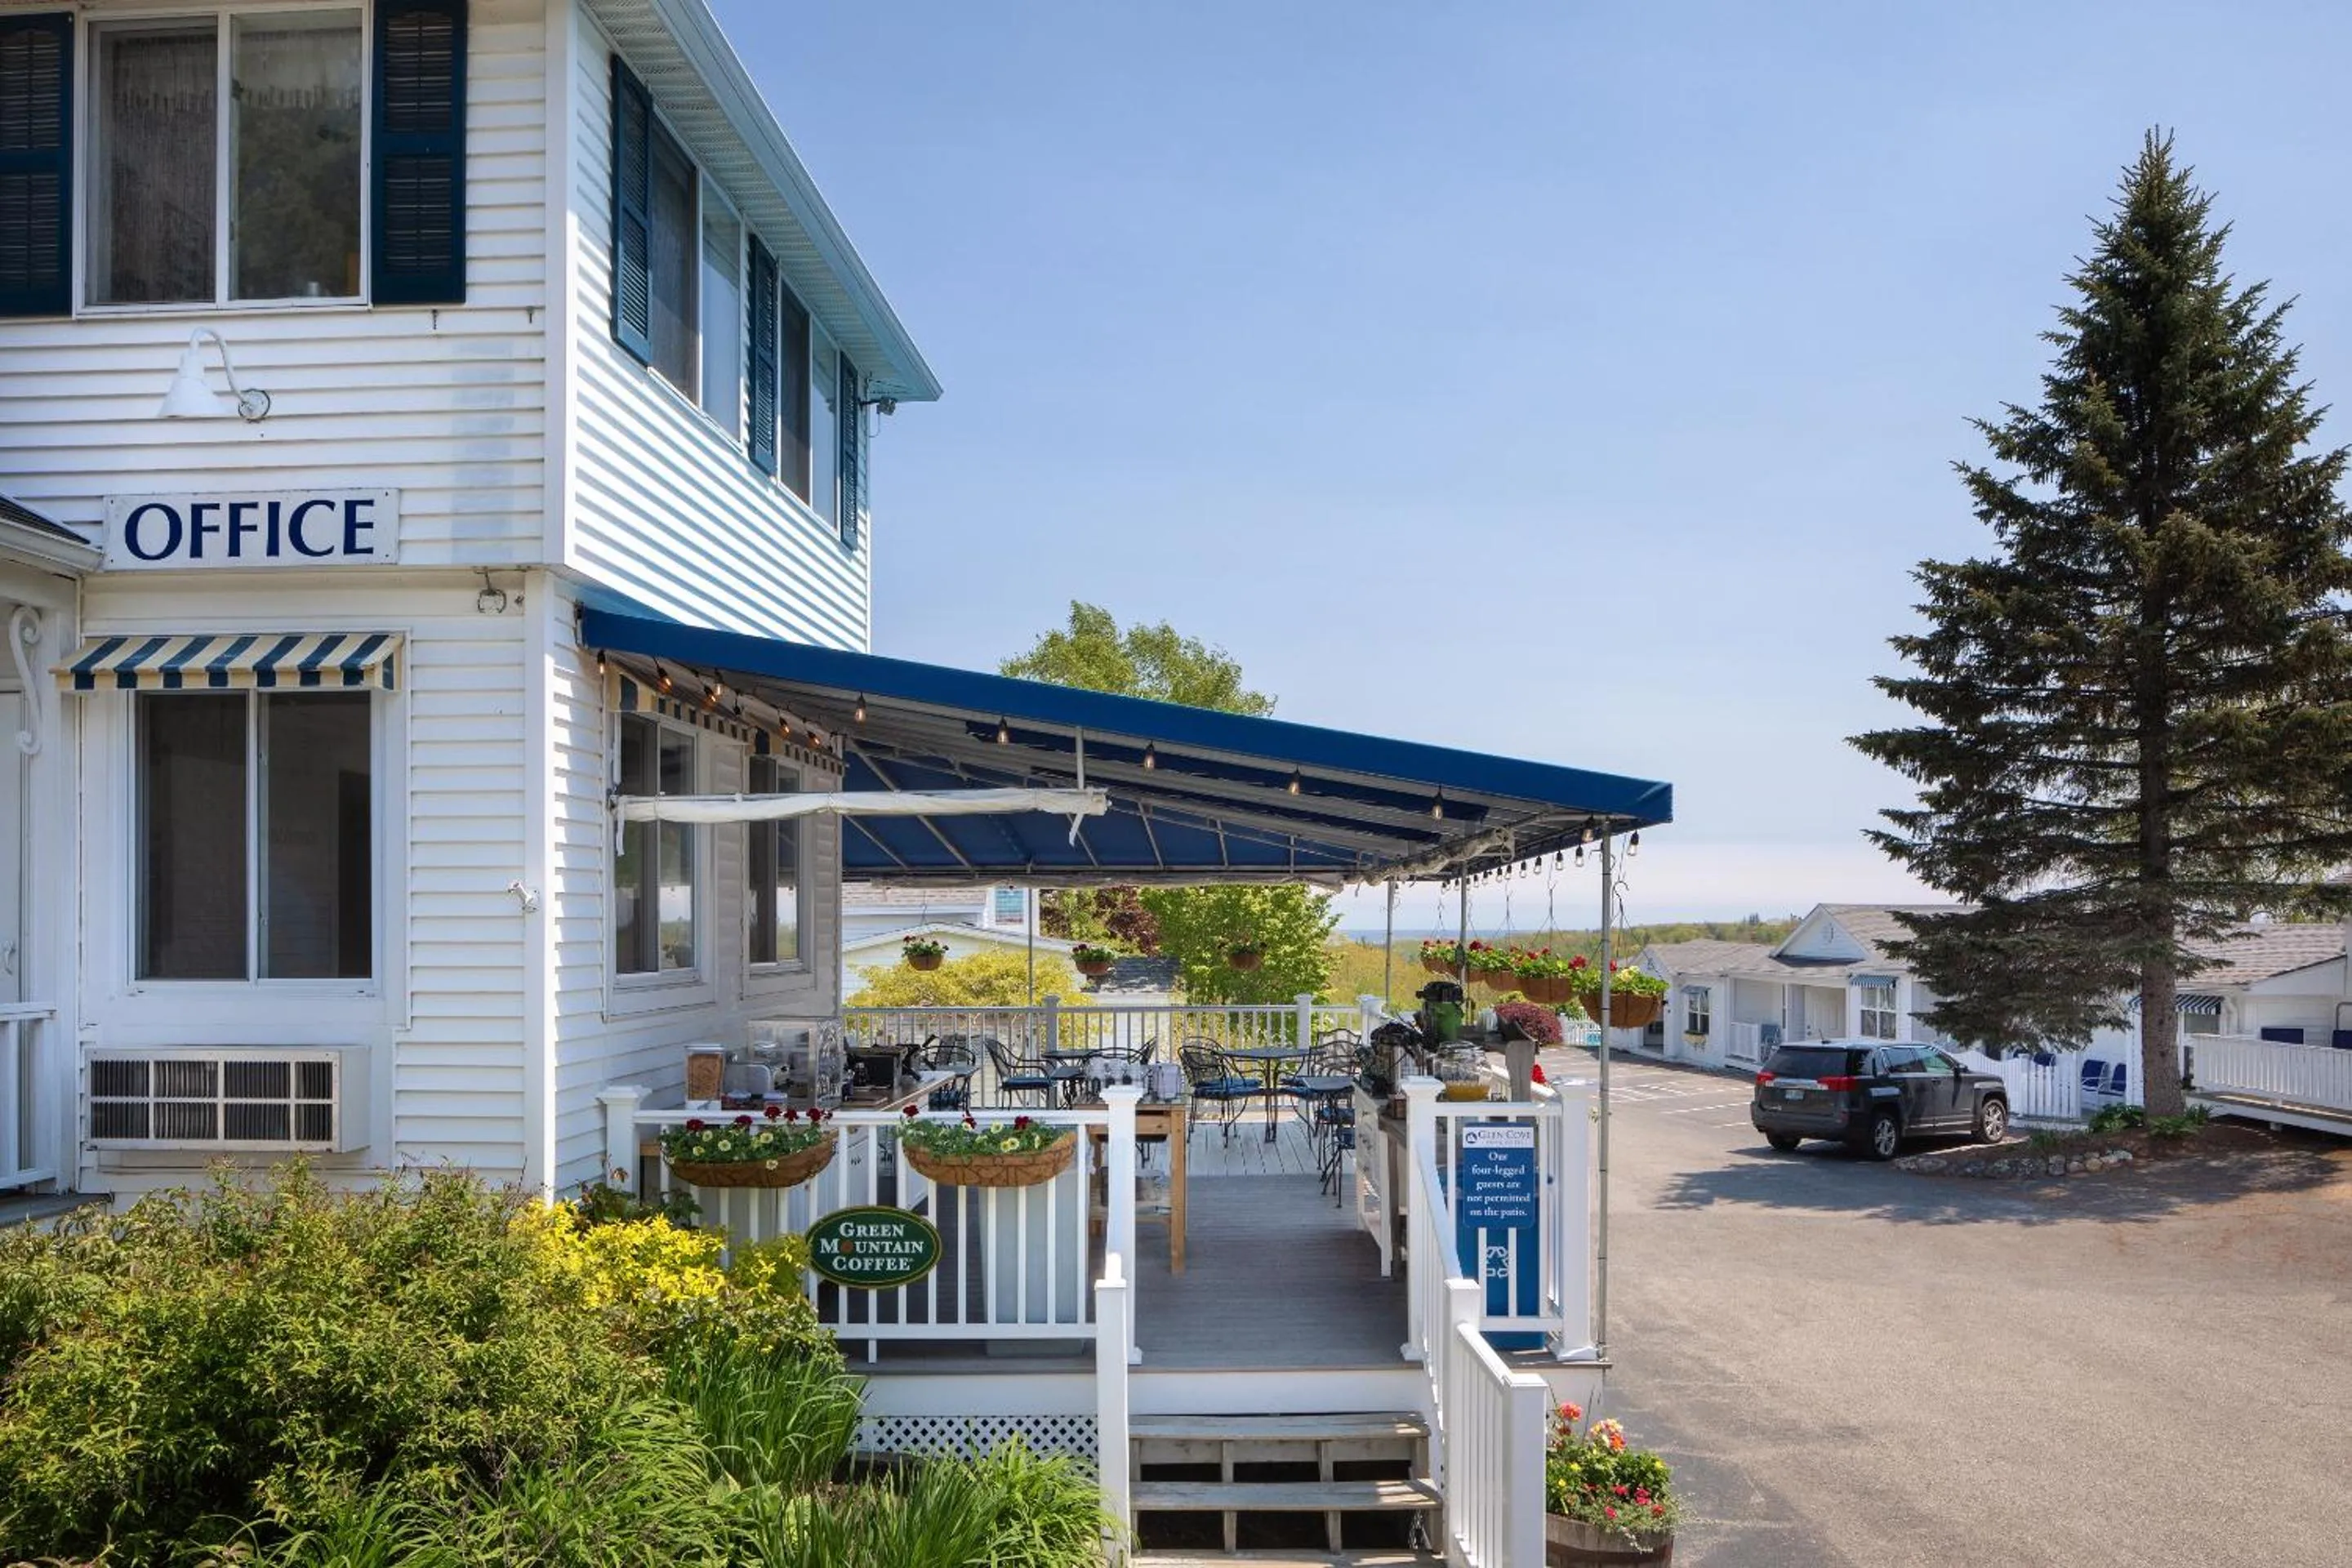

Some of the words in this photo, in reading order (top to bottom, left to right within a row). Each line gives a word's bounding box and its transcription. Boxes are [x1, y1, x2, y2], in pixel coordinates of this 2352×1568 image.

[124, 498, 375, 561] OFFICE
[1488, 1152, 1508, 1160] Our
[1472, 1164, 1525, 1178] four-legged
[1476, 1182, 1504, 1191] guests
[1484, 1192, 1530, 1205] permitted
[1484, 1206, 1499, 1216] the
[1500, 1207, 1528, 1219] patio.
[839, 1222, 905, 1237] GREEN
